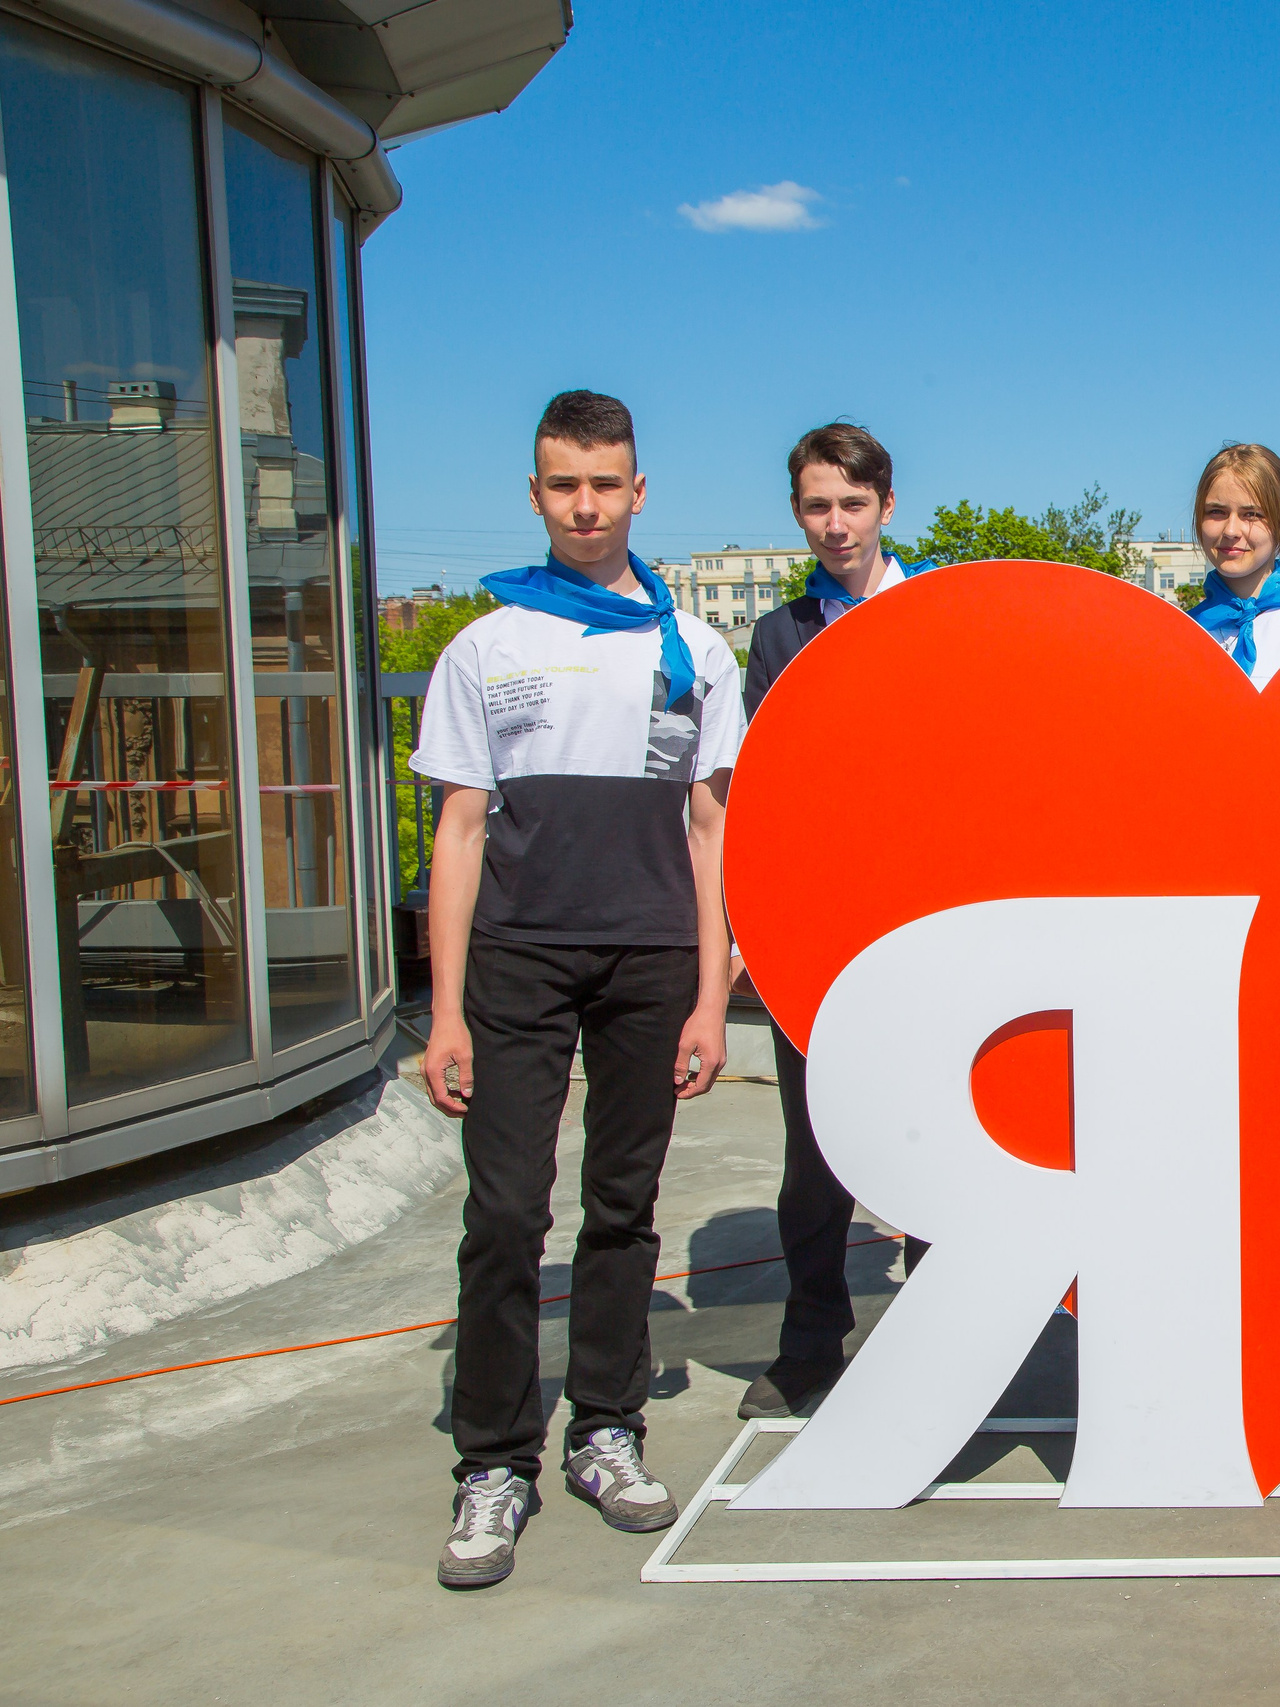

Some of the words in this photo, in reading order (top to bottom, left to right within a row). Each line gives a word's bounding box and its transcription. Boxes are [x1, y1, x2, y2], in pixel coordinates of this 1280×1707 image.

[487, 670, 527, 683] BELIEVE
[545, 665, 600, 674] YOURSELF
[496, 679, 525, 689] SOMETHING
[518, 684, 537, 692] FUTURE
[505, 696, 520, 704] THANK
[491, 707, 506, 715] EVERY
[499, 730, 522, 738] stronger
[725, 895, 1261, 1510] Я
